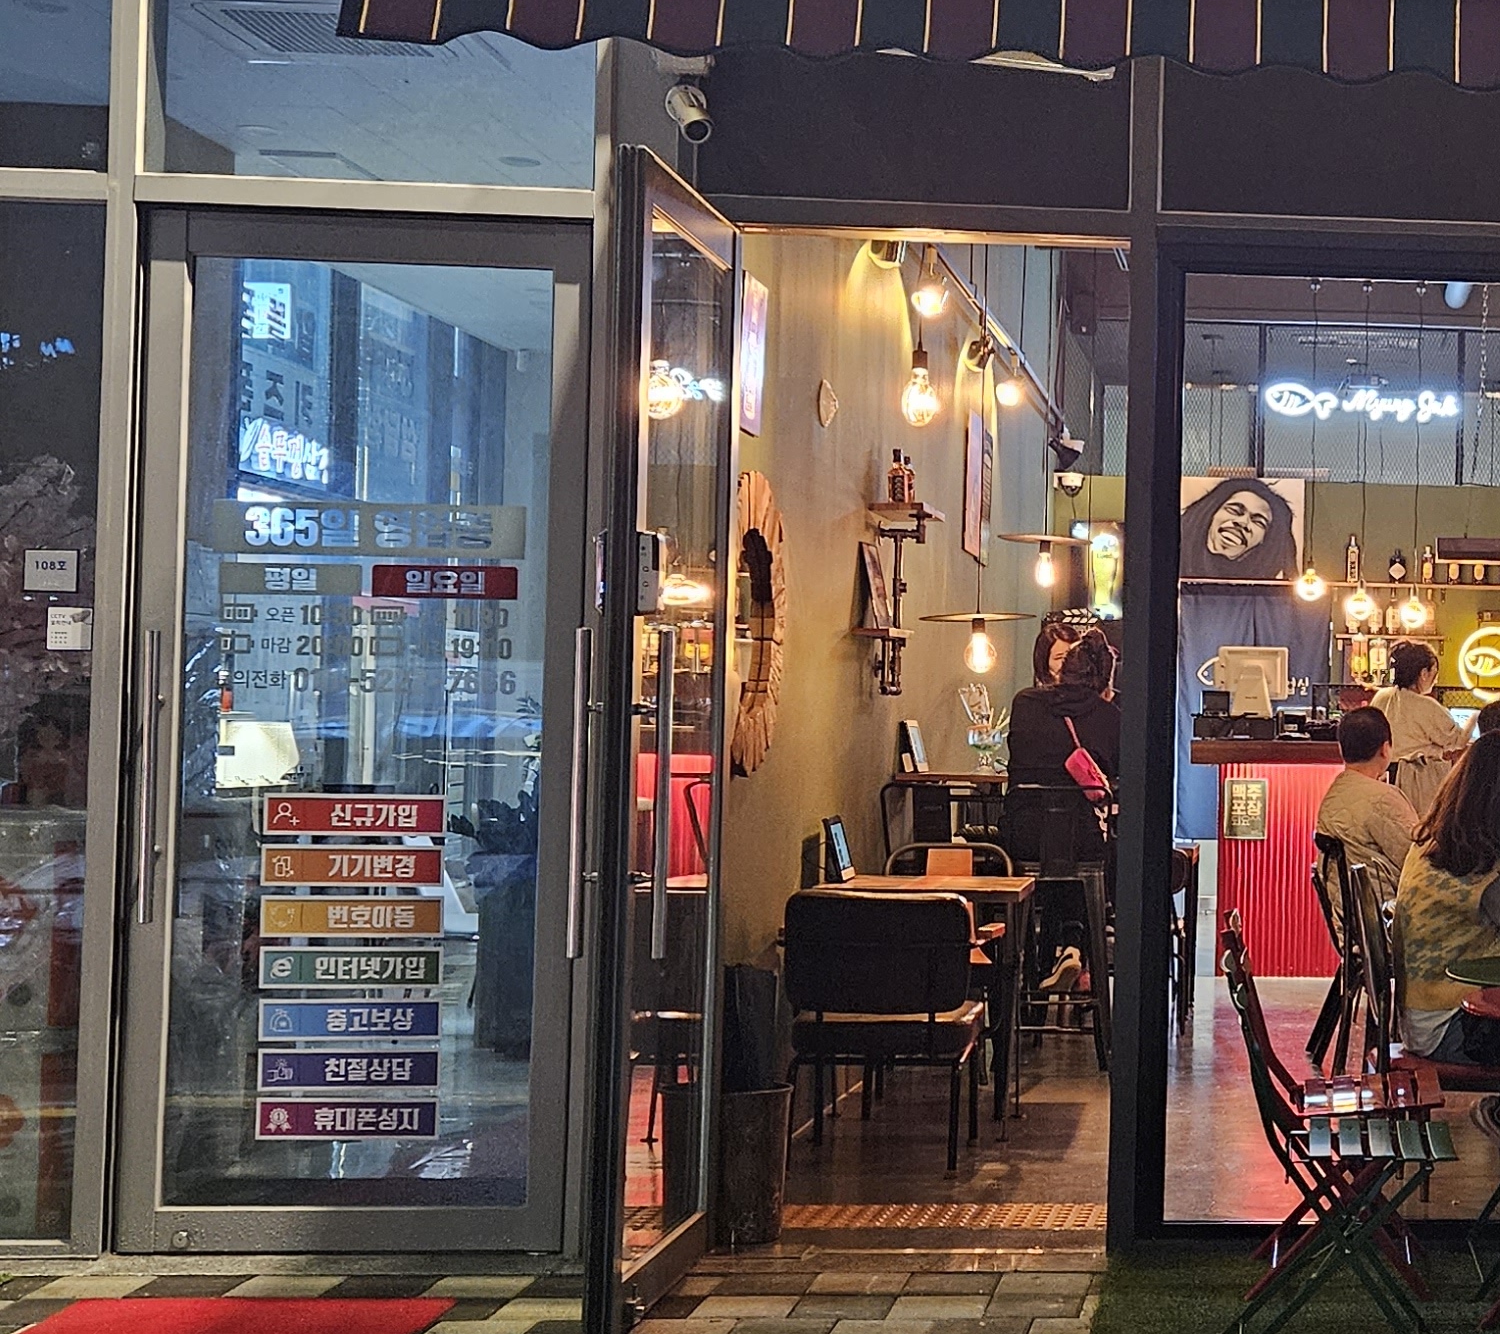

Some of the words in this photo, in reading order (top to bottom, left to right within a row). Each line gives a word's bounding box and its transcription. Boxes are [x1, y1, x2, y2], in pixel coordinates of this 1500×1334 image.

[244, 505, 360, 548] 365일
[34, 559, 67, 571] 108호
[264, 566, 318, 592] 평일
[405, 569, 486, 595] 일요일
[265, 607, 296, 623] 오픈
[261, 636, 292, 655] 마감
[219, 669, 287, 690] 의전화
[1232, 783, 1262, 800] 맥주
[329, 803, 418, 827] 신규가입
[1231, 800, 1263, 816] 포장
[327, 853, 416, 878] 기기변경
[327, 903, 416, 929] 번호이동
[314, 955, 426, 980] 인터넷가입
[325, 1007, 415, 1032] 중고보상
[324, 1057, 413, 1081] 친절상담
[313, 1105, 419, 1131] 휴대폰성지
